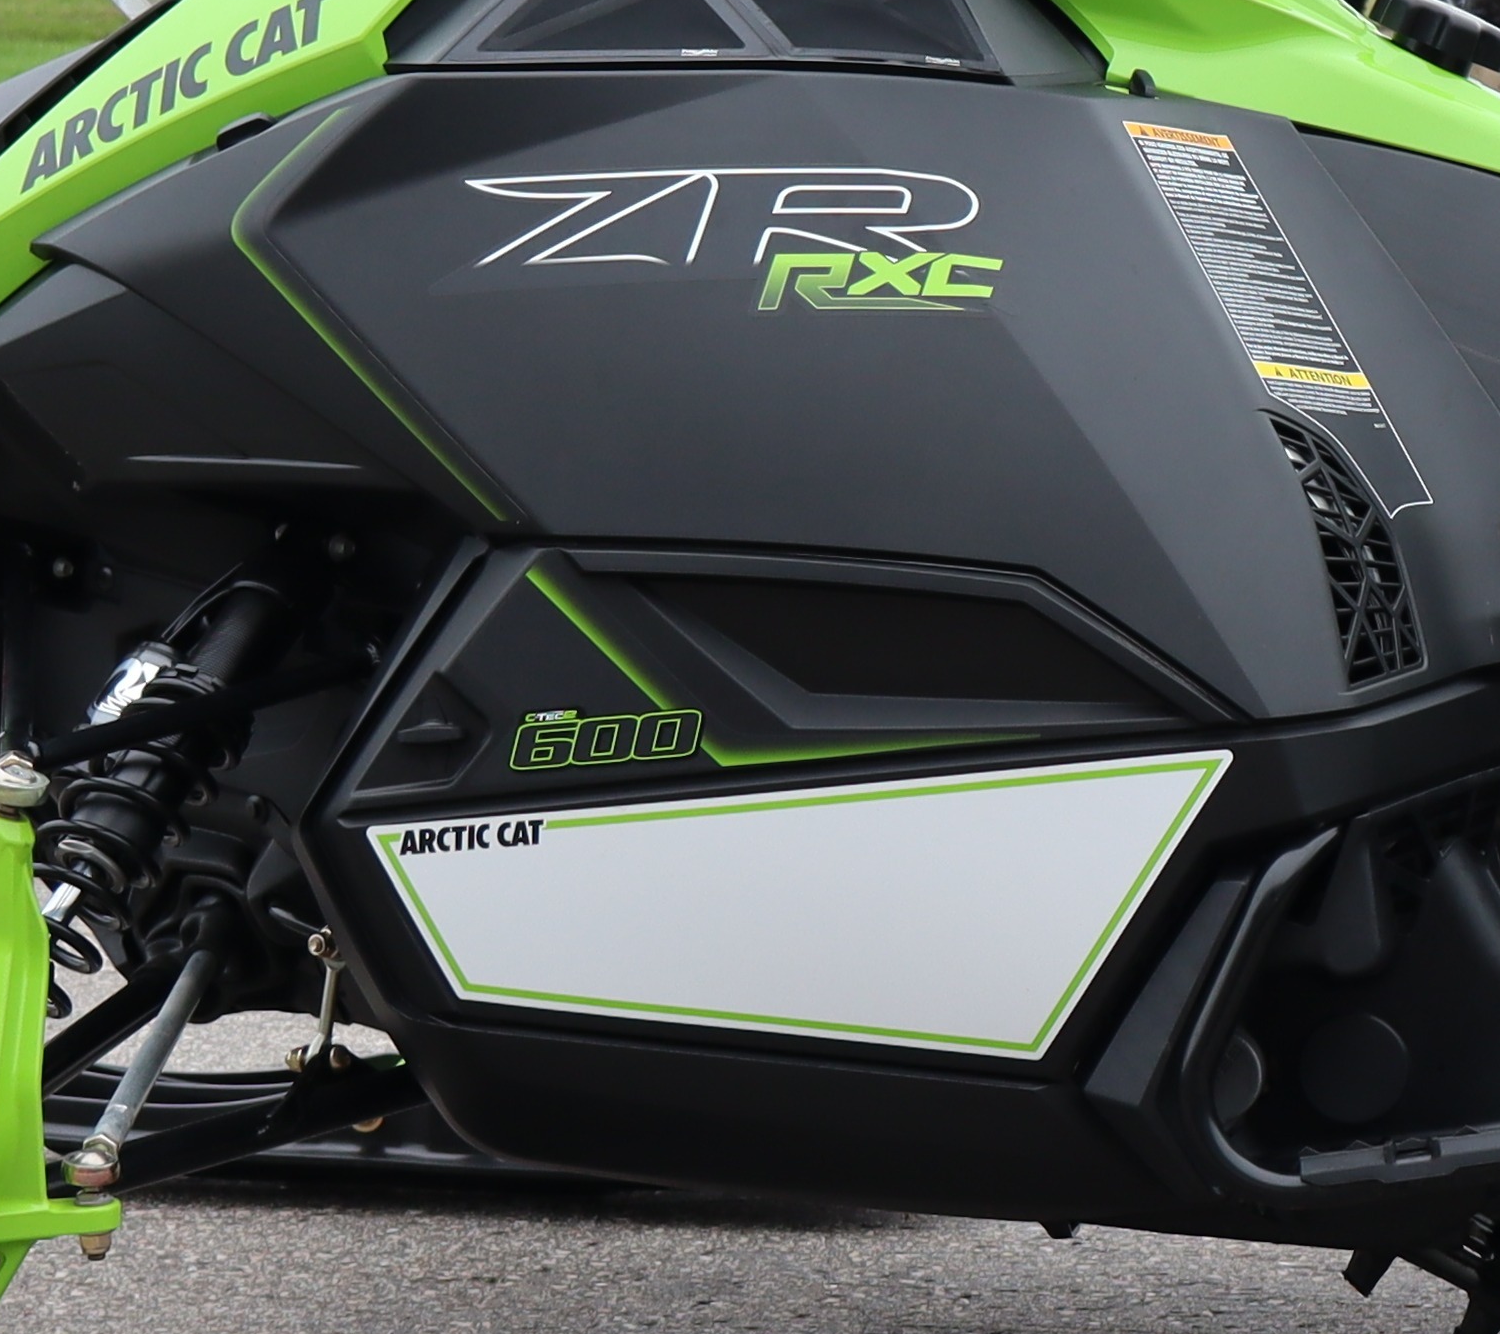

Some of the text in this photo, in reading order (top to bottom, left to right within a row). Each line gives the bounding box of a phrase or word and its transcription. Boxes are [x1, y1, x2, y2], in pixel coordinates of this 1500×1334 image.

[20, 41, 213, 194] ARCTIC
[757, 251, 1003, 312] RXC
[1289, 368, 1352, 386] ATTENTION
[509, 709, 702, 770] 600
[400, 819, 544, 855] ARCTIC CAT
